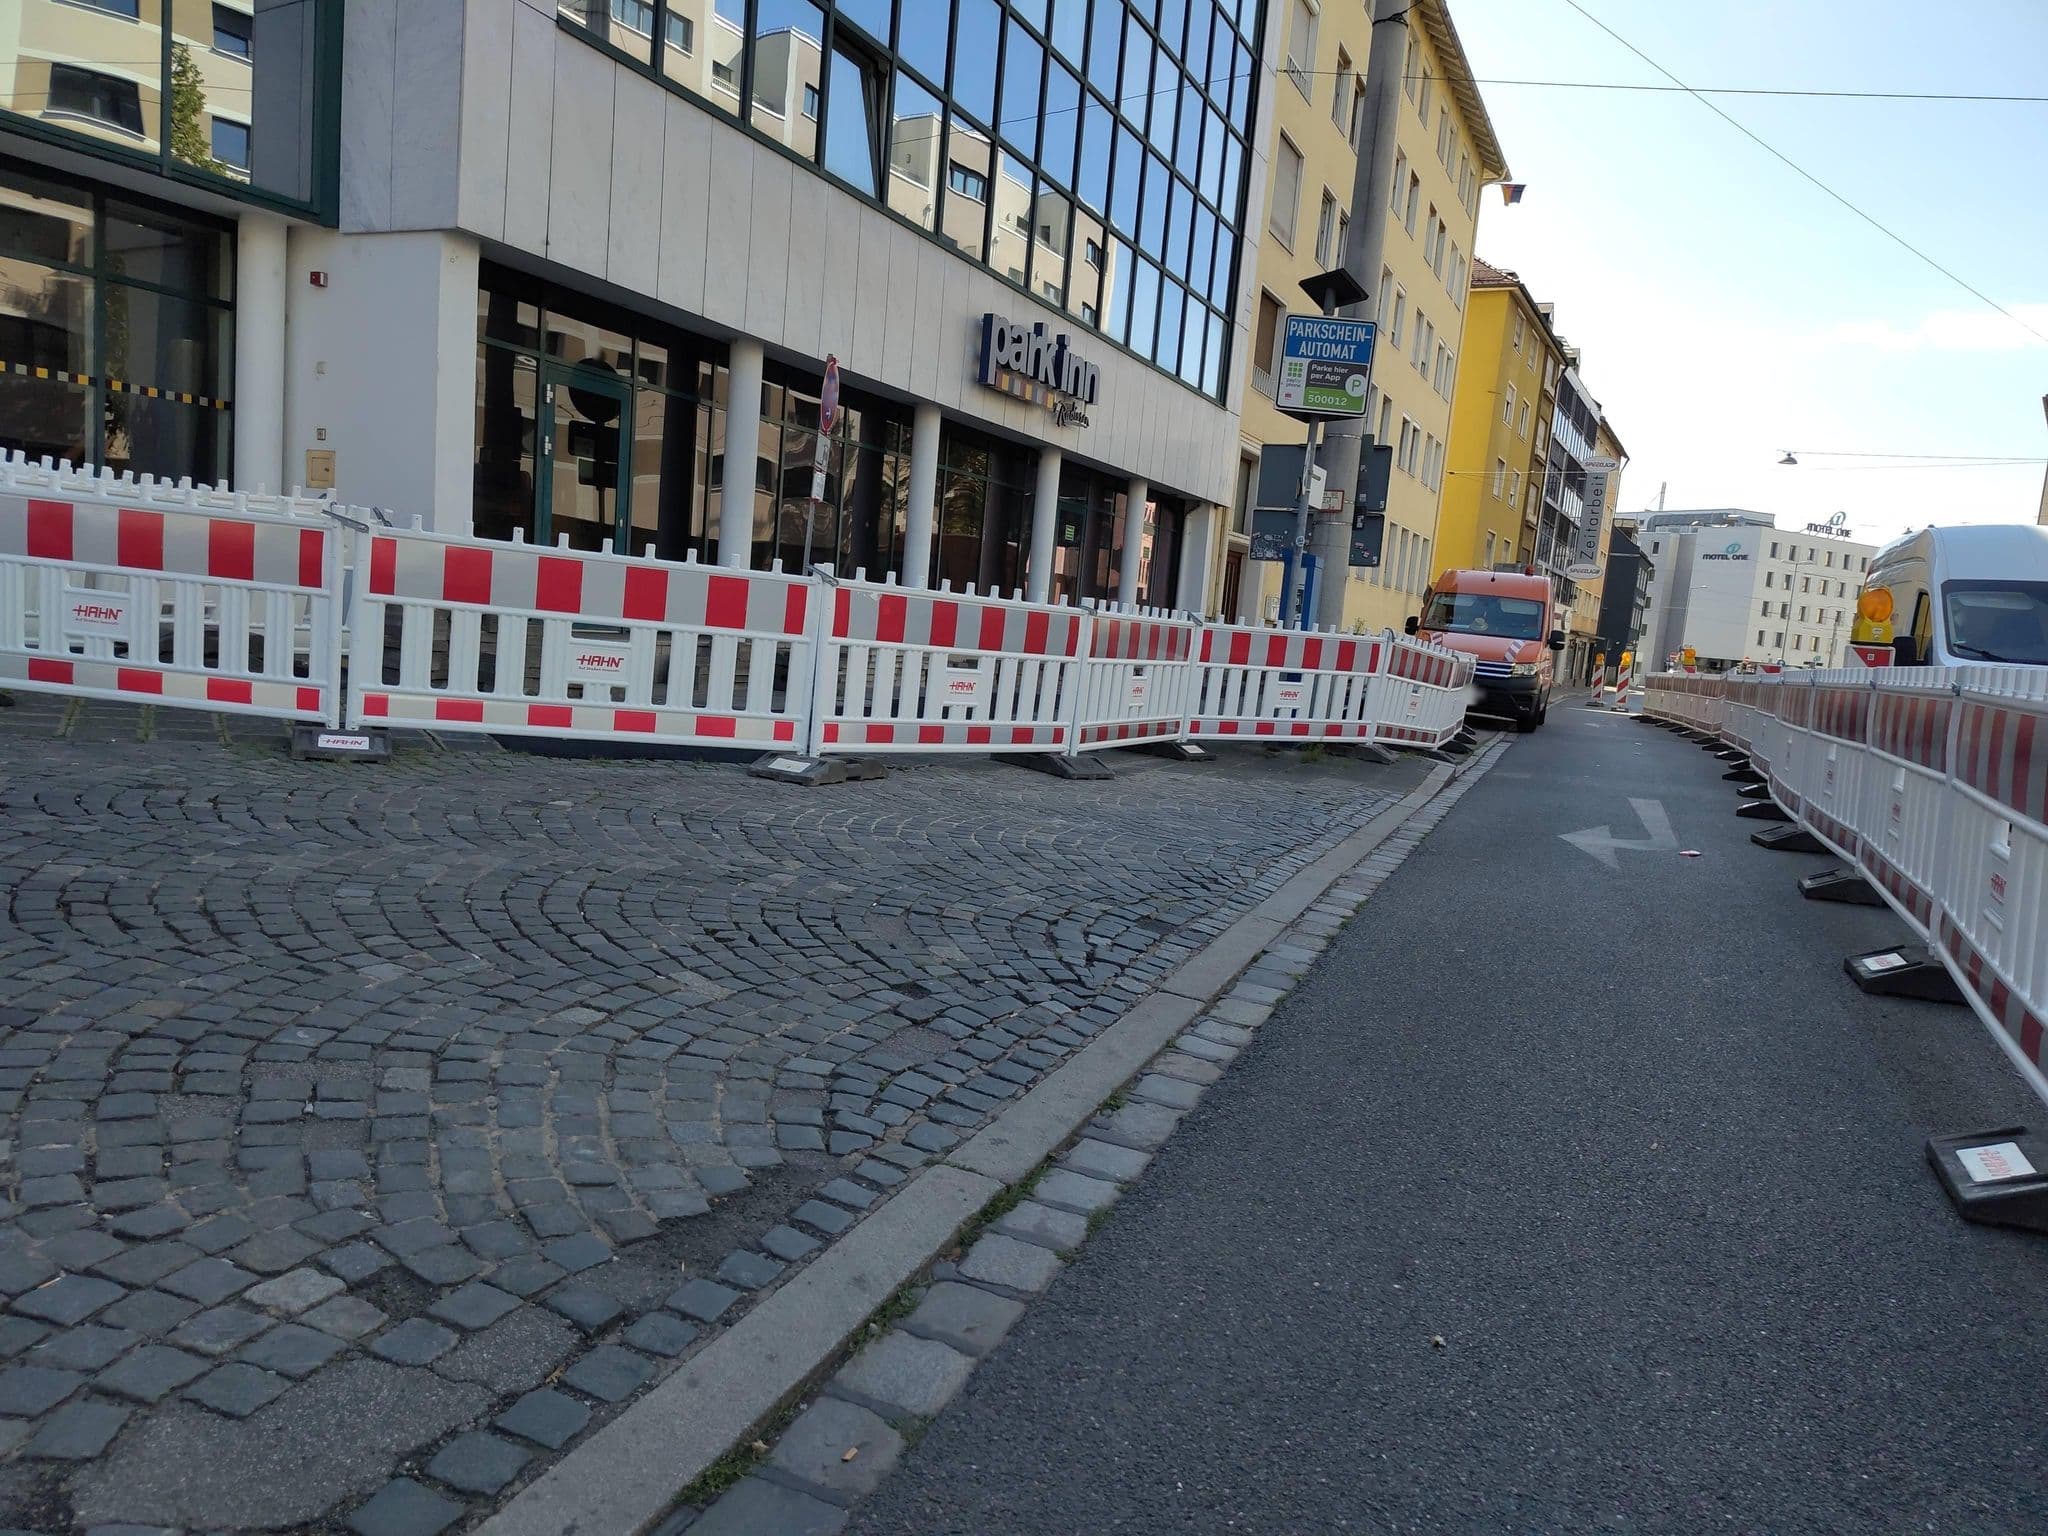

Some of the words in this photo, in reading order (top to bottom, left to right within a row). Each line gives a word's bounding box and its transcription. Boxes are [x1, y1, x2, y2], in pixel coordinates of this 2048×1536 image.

[1289, 321, 1372, 342] PARKSCHEIN-
[1298, 341, 1357, 360] AUTOMAT
[978, 313, 1057, 389] park
[1056, 334, 1101, 406] inn
[1311, 364, 1333, 373] Parke
[1334, 366, 1349, 374] hier
[1310, 372, 1324, 381] per
[1324, 374, 1341, 382] App
[1307, 394, 1348, 406] 500012
[1580, 474, 1606, 561] Zeitarbeit
[1806, 522, 1830, 536] MOTEL
[1831, 527, 1853, 538] ONE
[1702, 552, 1730, 561] MOTEL
[1731, 553, 1750, 561] ONE
[72, 604, 123, 621] HAHN
[576, 654, 625, 668] HAHN
[949, 681, 976, 691] HAHN
